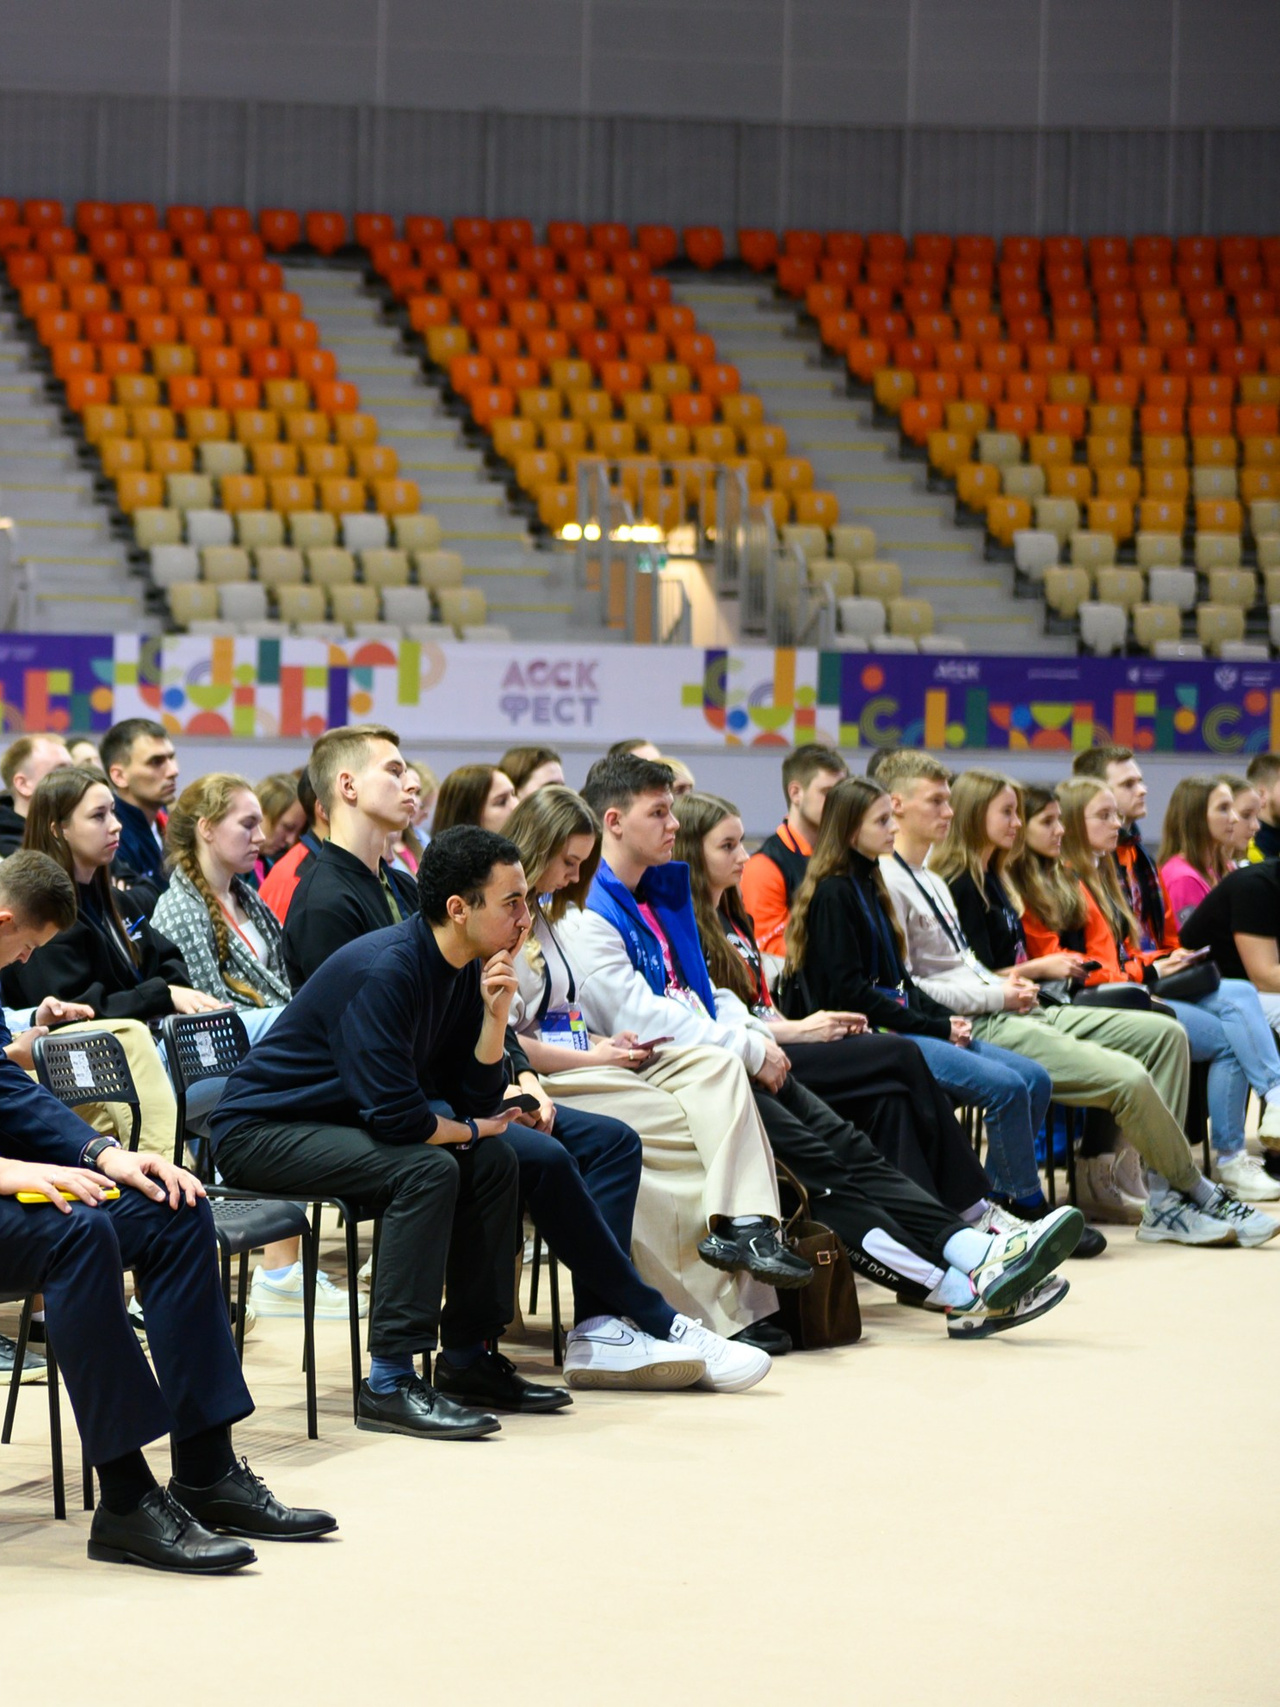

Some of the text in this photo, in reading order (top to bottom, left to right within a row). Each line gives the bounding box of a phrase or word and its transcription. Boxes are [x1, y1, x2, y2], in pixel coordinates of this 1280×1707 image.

[501, 659, 599, 691] АССК
[499, 695, 599, 726] ФЕСТ
[844, 1246, 900, 1283] UST DO IT
